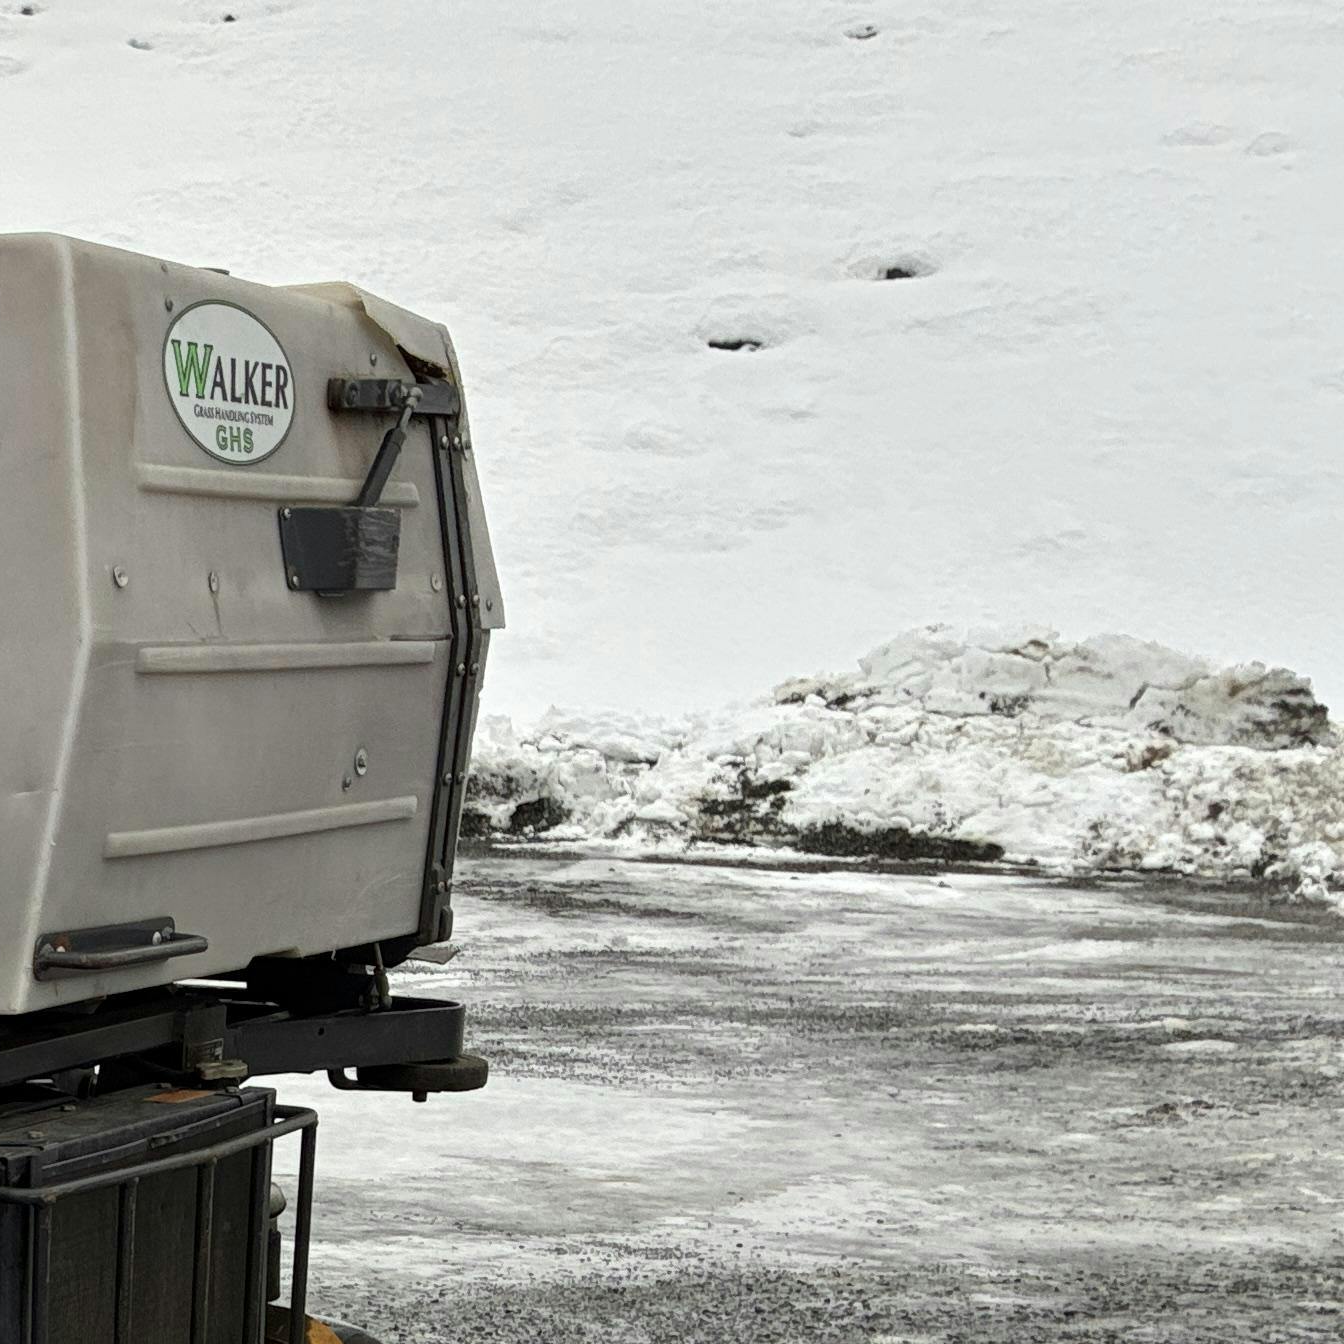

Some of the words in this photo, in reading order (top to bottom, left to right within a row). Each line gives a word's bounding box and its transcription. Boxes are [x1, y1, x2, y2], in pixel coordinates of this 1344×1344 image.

[170, 338, 290, 410] WALKER
[193, 403, 215, 419] GRASS
[215, 407, 250, 424] HANDLING
[250, 411, 274, 426] SYSTEM
[215, 424, 254, 453] GHS
